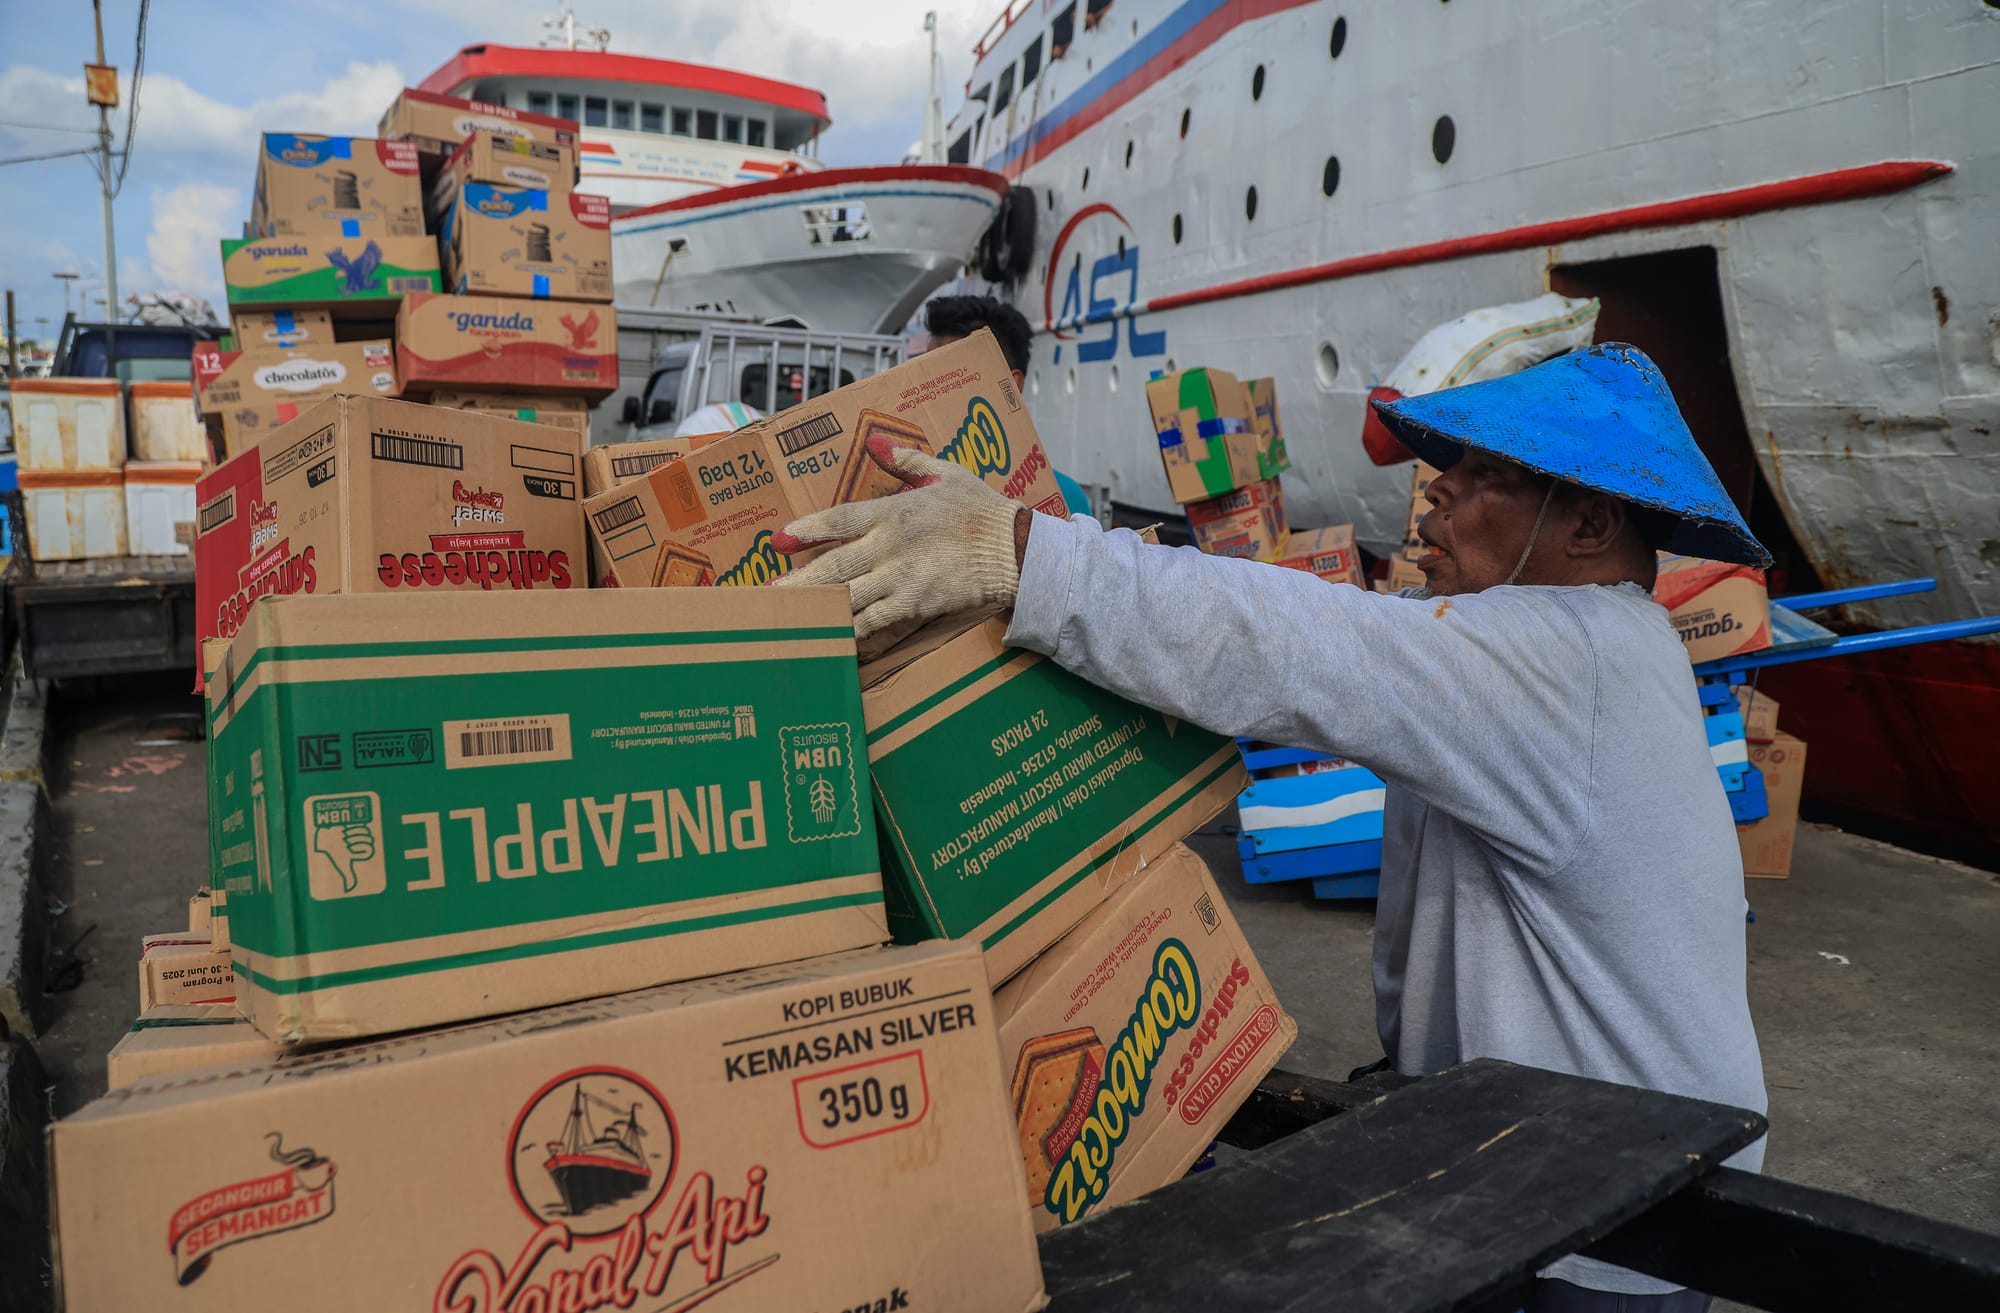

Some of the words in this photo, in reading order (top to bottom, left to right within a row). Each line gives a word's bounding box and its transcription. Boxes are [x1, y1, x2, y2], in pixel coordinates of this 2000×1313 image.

[252, 242, 307, 261] garuda
[1054, 246, 1166, 364] ASL
[456, 312, 534, 331] garuda
[200, 354, 221, 369] 12
[920, 379, 937, 392] Wafer
[936, 369, 963, 385] Chocolate
[941, 379, 962, 394] Biscuits
[962, 372, 981, 385] Cheese
[900, 386, 919, 399] Cream
[915, 391, 937, 405] Cheese
[896, 399, 916, 412] Cream
[737, 450, 765, 475] 12
[787, 456, 821, 479] Bag
[819, 448, 839, 468] 12
[317, 464, 326, 480] 30
[698, 460, 738, 487] bag
[736, 471, 774, 496] OUTER
[453, 480, 492, 507] spicy
[543, 481, 559, 495] 30
[709, 488, 734, 505] BAG
[452, 505, 504, 527] sweet
[712, 517, 729, 529] Wafer
[728, 506, 758, 520] Chocolate
[755, 508, 778, 522] Cheese
[693, 524, 712, 536] Cream
[706, 528, 727, 540] Cheese
[732, 519, 755, 531] Biscuits
[252, 521, 278, 557] sweet
[450, 539, 471, 548] keju
[474, 536, 511, 546] krekers
[688, 536, 706, 547] Cream
[377, 550, 572, 590] Saltcheese
[640, 710, 674, 720] Indonesia
[696, 720, 720, 730] UNITED
[720, 720, 730, 728] PT
[1032, 709, 1049, 732] 24
[1132, 715, 1147, 736] PT
[591, 725, 645, 738] MANUFACTORY
[647, 724, 673, 733] BISCUIT
[674, 722, 695, 732] WARU
[695, 732, 732, 743] Diproduksi
[991, 720, 1034, 757] PACKS
[1055, 714, 1103, 750] Sidoarjo,
[615, 739, 624, 749] By
[625, 736, 673, 749] Manufactured
[678, 734, 695, 744] Oleh
[793, 733, 838, 746] BISCUITS
[1094, 723, 1133, 759] UNITED
[298, 735, 342, 771] SNI
[359, 747, 404, 758] HALAL
[794, 746, 841, 770] UBM
[1022, 744, 1057, 777] 61256
[1062, 751, 1096, 779] WARU
[1088, 746, 1144, 794] Diproduksi
[959, 770, 1018, 815] Indonesia
[1020, 771, 1064, 811] BISCUIT
[1062, 784, 1089, 810] Oleh
[317, 809, 350, 824] UBM
[401, 780, 768, 891] PINEAPPLE
[931, 799, 1020, 871] MANUFACTORY
[979, 804, 1059, 870] Manufactured
[964, 857, 982, 880] By
[1147, 907, 1172, 935] Cheese
[1116, 916, 1150, 953] Chocolate
[1121, 933, 1148, 962] Biscuits
[162, 969, 185, 980] 2025
[187, 966, 208, 977] Juni
[211, 965, 222, 975] 30
[1096, 952, 1117, 976] Wafer
[182, 975, 223, 988] Program
[1070, 974, 1095, 1000] Cream
[1088, 967, 1116, 997] Cheese
[783, 994, 835, 1022] KOPI
[840, 977, 914, 1009] BUBUK
[1064, 996, 1089, 1022] Cream
[724, 1027, 874, 1082] KEMASAN
[880, 1004, 976, 1047] SILVER
[1163, 958, 1249, 1106] Saltcheese
[1223, 1028, 1262, 1077] KHONG
[1052, 946, 1195, 1222] Combociz
[1073, 1078, 1090, 1112] WAFER
[1084, 1073, 1098, 1111] BISKUIT
[819, 1076, 883, 1129] 350
[890, 1083, 909, 1120] g
[1186, 1075, 1221, 1117] GUAN
[1049, 1114, 1075, 1148] COKLAT
[1069, 1111, 1084, 1135] KRIM
[1052, 1135, 1071, 1157] KEJU
[186, 1191, 325, 1257] SEMANGAT
[644, 1165, 769, 1296] Api
